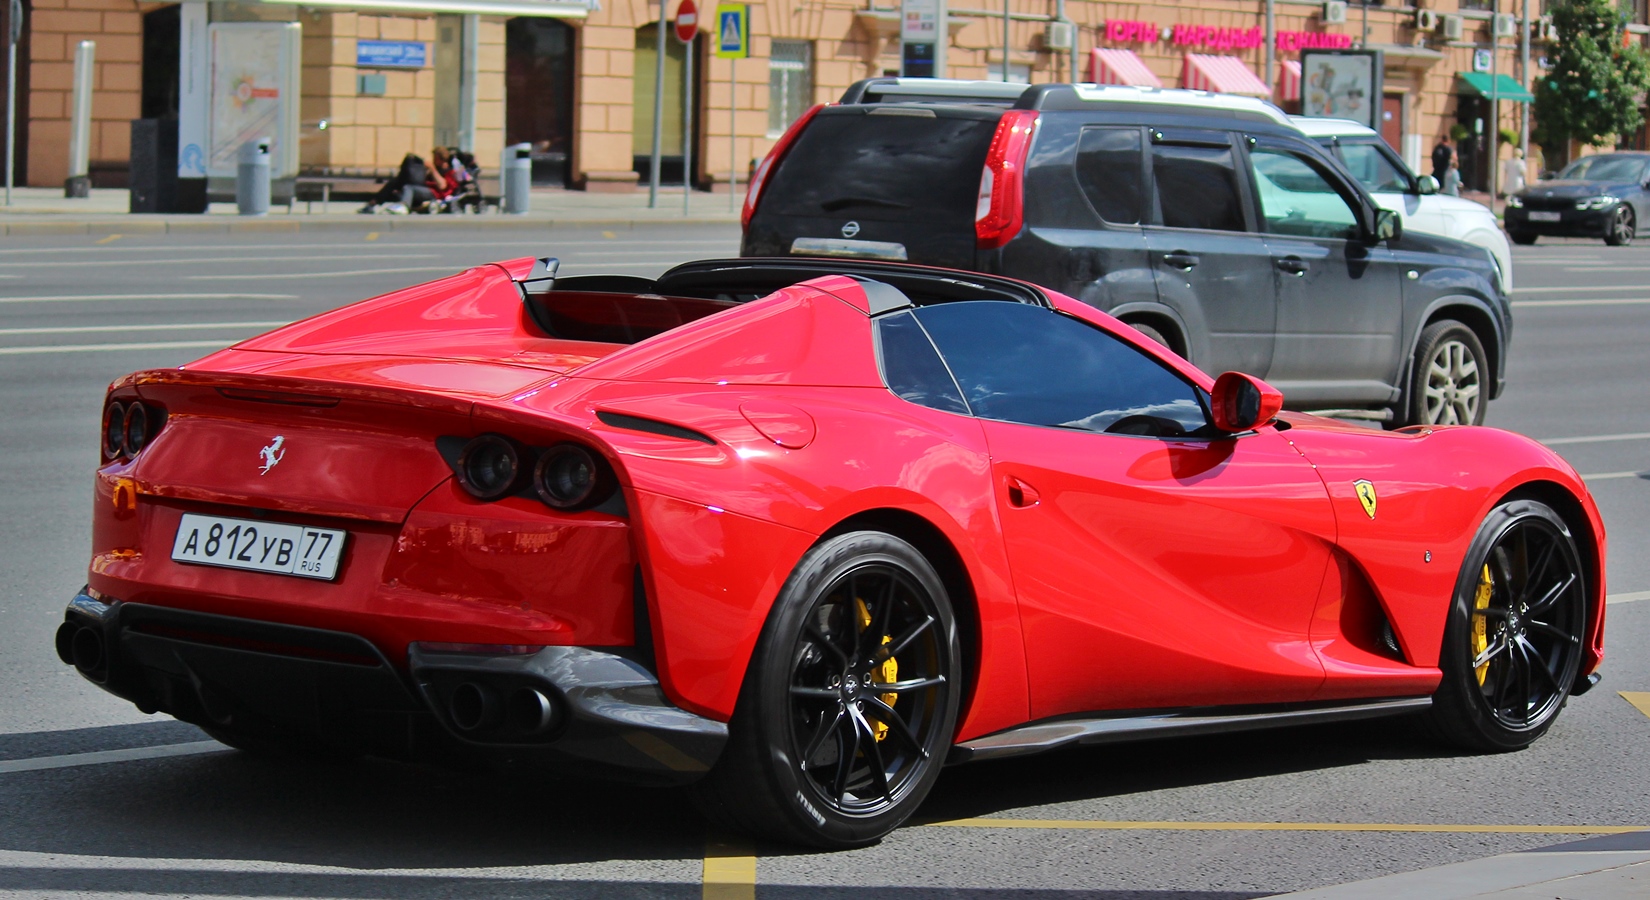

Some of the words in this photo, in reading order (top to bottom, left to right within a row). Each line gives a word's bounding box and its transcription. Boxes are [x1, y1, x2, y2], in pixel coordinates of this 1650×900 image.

[1173, 24, 1262, 50] НАРОДНЫЙ
[303, 531, 334, 561] 77
[300, 560, 322, 573] RUS
